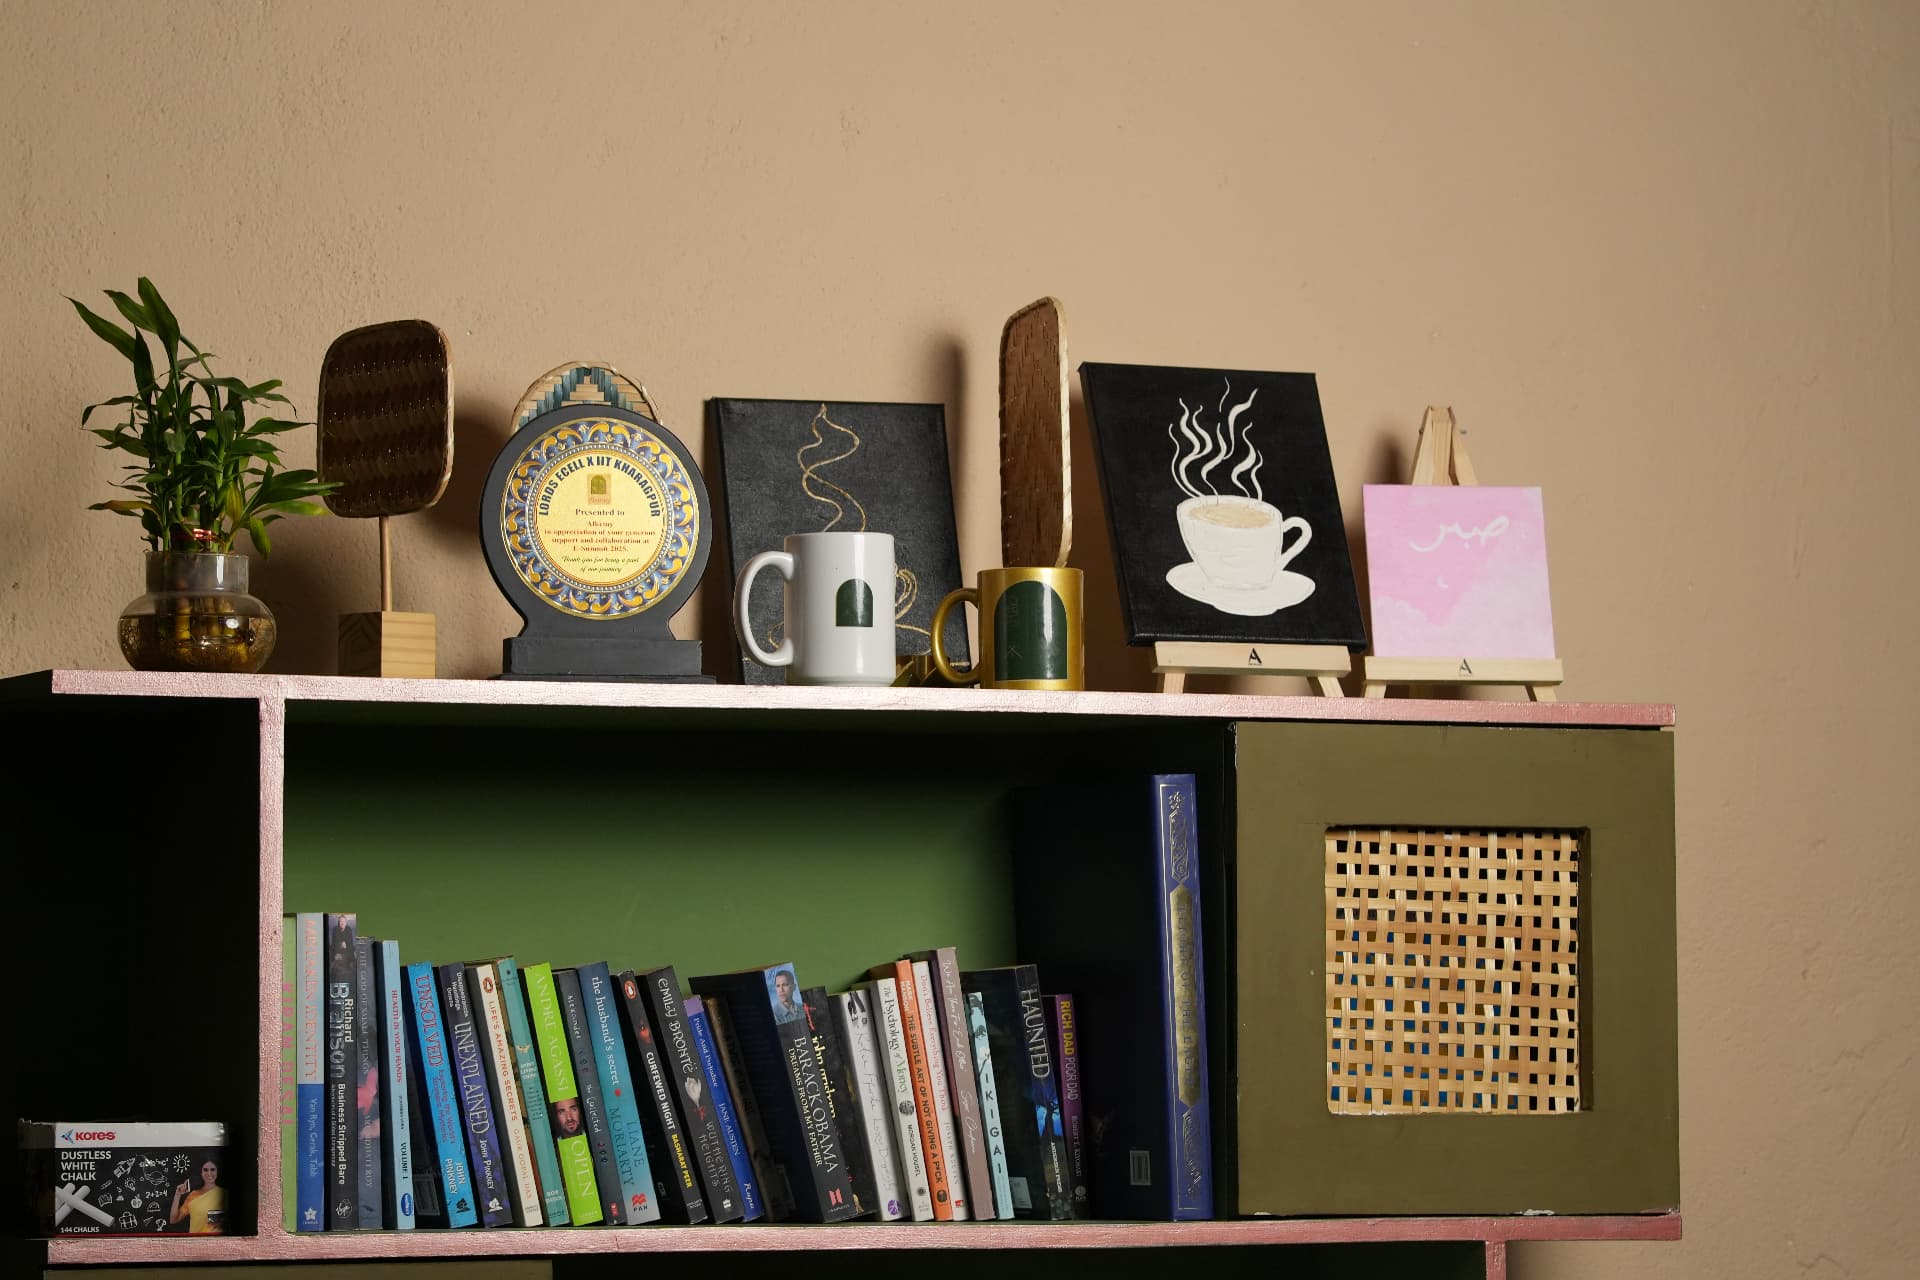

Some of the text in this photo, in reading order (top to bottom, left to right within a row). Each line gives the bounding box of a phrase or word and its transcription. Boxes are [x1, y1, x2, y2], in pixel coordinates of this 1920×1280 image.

[539, 456, 660, 517] LORDS ECELL X IIT KHARAGPUR
[575, 508, 614, 516] Presented
[360, 970, 368, 992] GOD
[392, 989, 400, 1021] HEALTH
[304, 1005, 318, 1082] IDENTITY
[329, 983, 350, 1078] Branson
[345, 998, 354, 1043] Richard
[415, 975, 443, 1068] UNSOLVED
[536, 971, 568, 1091] ANDRE AGASSI
[591, 976, 620, 1086] the husband's secret
[884, 999, 901, 1051] Psychology
[895, 1057, 908, 1093] Money
[907, 1015, 916, 1033] THE
[1021, 989, 1050, 1078] HAUNTED
[361, 1039, 369, 1074] THINGS
[395, 1055, 403, 1083] HANDS
[489, 1001, 518, 1121] LIFE'S AMAZING SECRETS
[693, 1017, 718, 1088] Pride And Prejudice
[910, 1034, 920, 1065] SUBTLE
[915, 1066, 925, 1083] ART
[1060, 1001, 1078, 1101] RICH DAD POOR DAD
[454, 1020, 490, 1134] UNEXPLAINED
[646, 1051, 676, 1130] CURFEWED NIGHT
[920, 1086, 927, 1098] OF
[719, 1103, 741, 1156] JANE AUSTEN
[788, 1047, 823, 1168] DREAMS FROM MY FATHER
[794, 1036, 823, 1108] BARACK
[812, 1106, 839, 1173] OBAMA
[921, 1100, 931, 1119] NOT
[985, 1073, 1002, 1174] IKIGAI
[61, 1150, 112, 1160] DUSTLESS
[75, 1131, 116, 1141] Kores
[337, 1083, 347, 1185] Business Stripped Bare
[400, 1142, 408, 1172] VOLUME
[609, 1107, 635, 1186] MORIARTY
[626, 1120, 644, 1168] LIANE
[699, 1134, 721, 1187] HEIGHTS
[705, 1121, 734, 1193] WUTHERING
[907, 1124, 920, 1177] MORGAN HOUSEL
[925, 1120, 937, 1151] GIVING
[60, 1172, 97, 1181] CHALK
[61, 1161, 96, 1170] WHITE
[446, 1158, 458, 1194] PINKNEY
[456, 1162, 465, 1185] JOHN
[571, 1140, 594, 1197] OPEN
[671, 1133, 693, 1189] BASHARAT PEER
